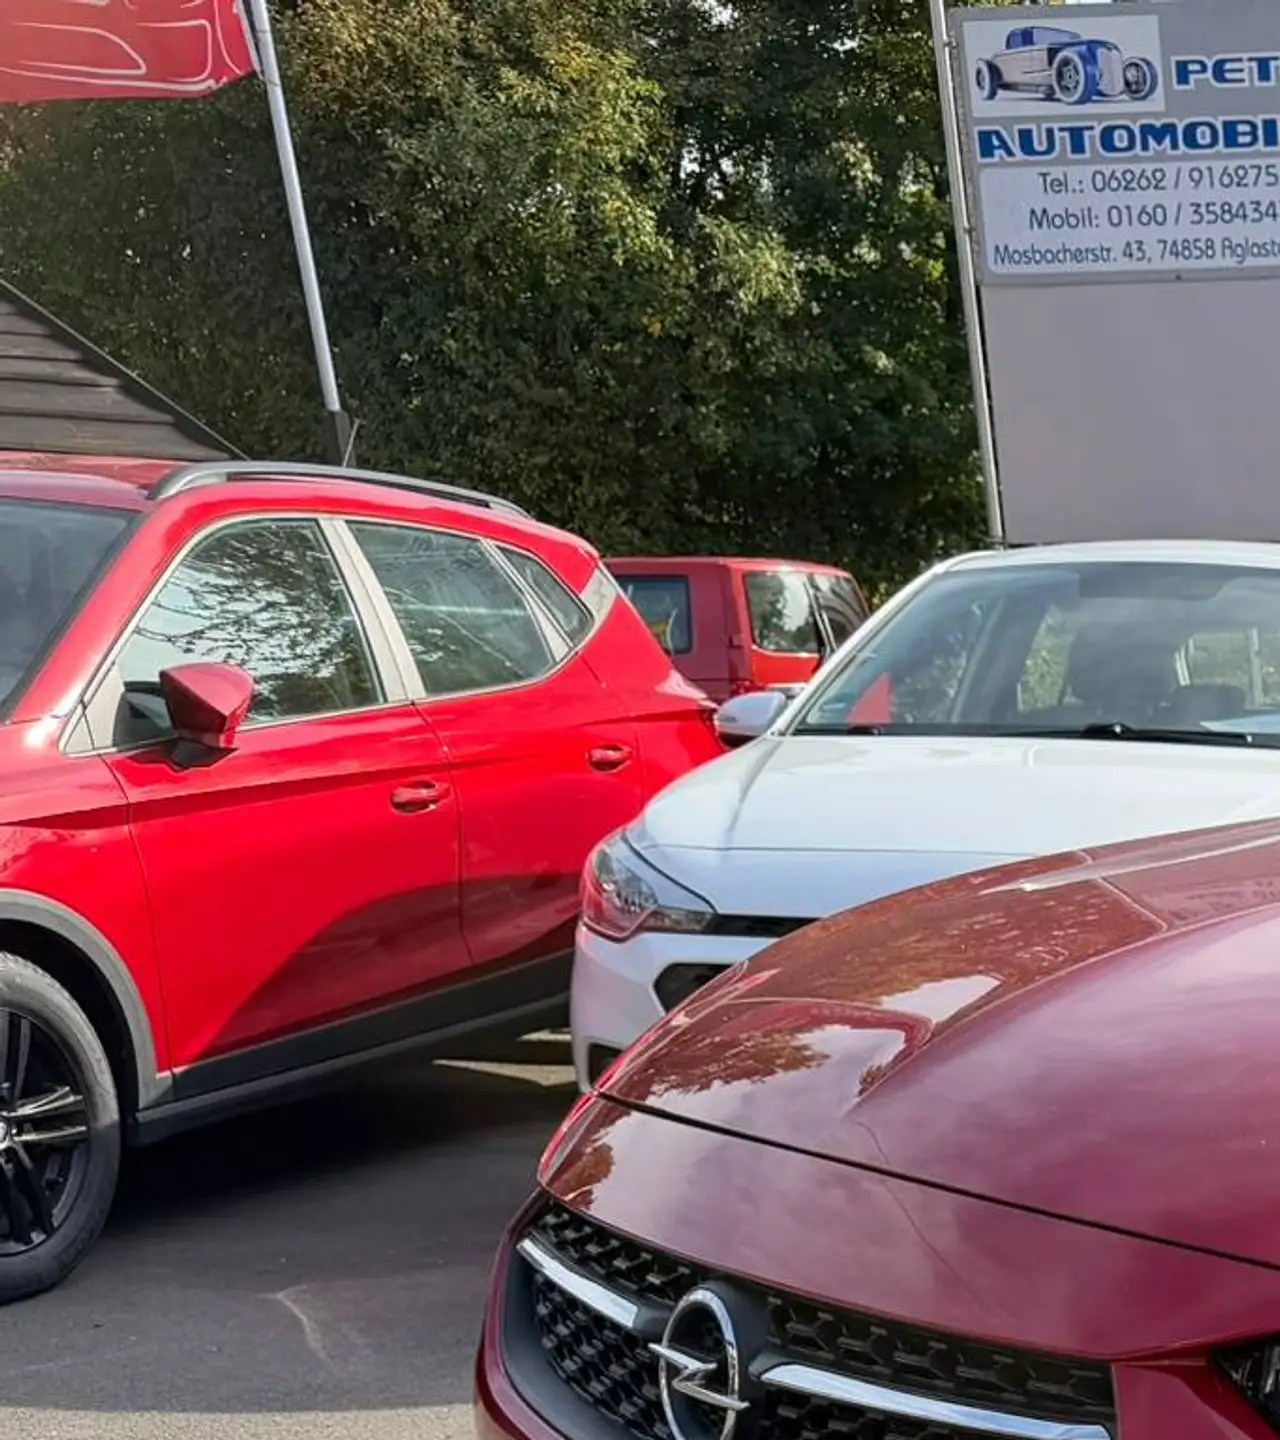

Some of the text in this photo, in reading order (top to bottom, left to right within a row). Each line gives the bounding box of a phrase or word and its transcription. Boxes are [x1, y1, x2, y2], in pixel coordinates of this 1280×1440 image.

[1038, 163, 1280, 196] Tel.: 06262 / 916275
[1028, 205, 1100, 231] Mobil:
[1108, 205, 1168, 229] 0160
[1174, 203, 1182, 227] /
[993, 241, 1117, 267] Mosbacherstr.
[1122, 239, 1153, 265] 43,
[1158, 236, 1216, 262] 74858
